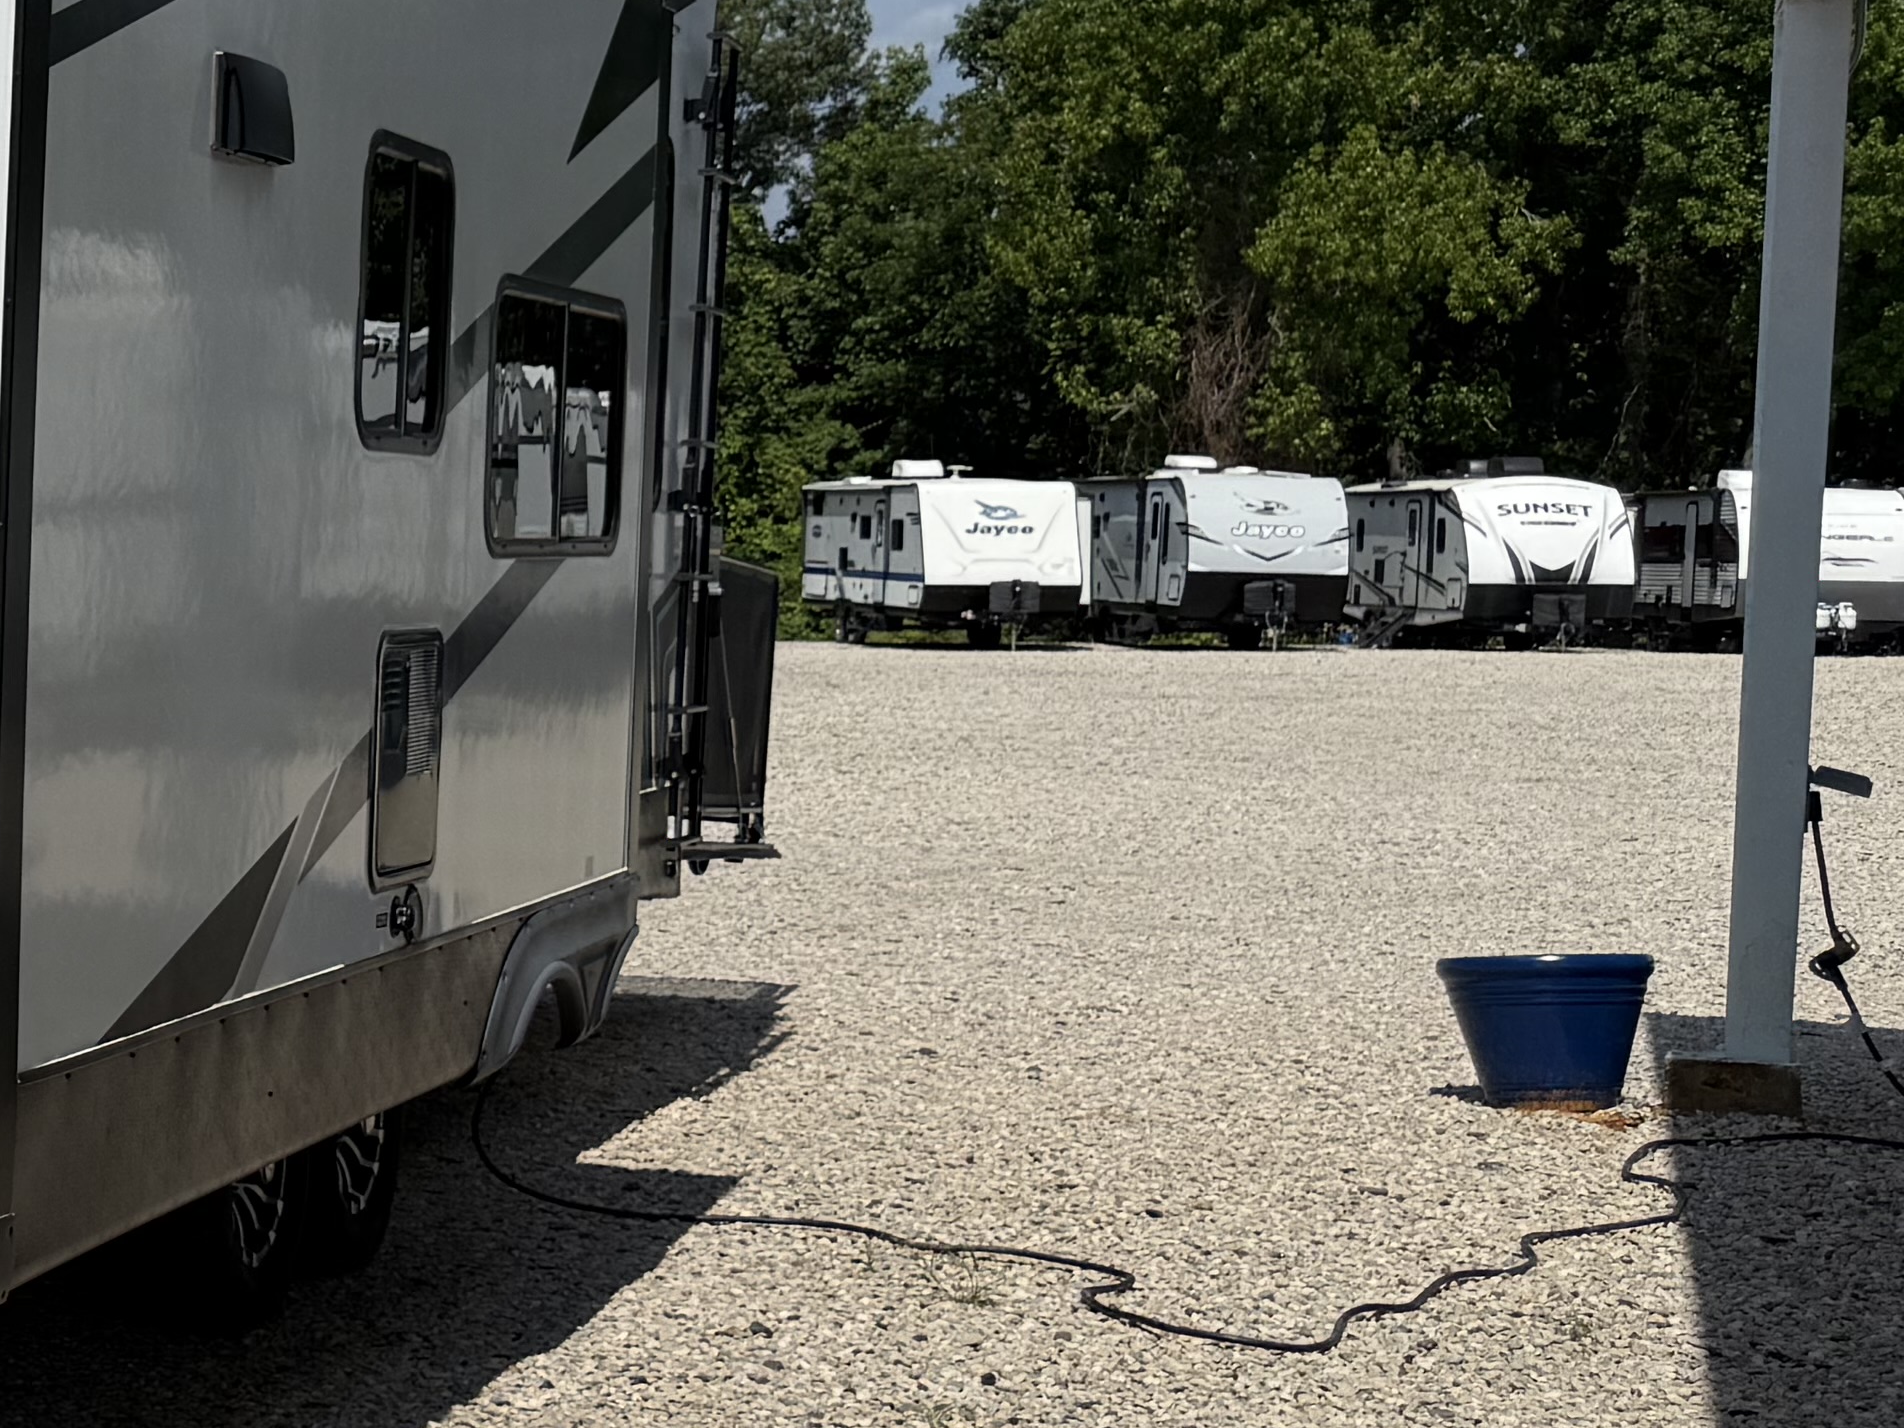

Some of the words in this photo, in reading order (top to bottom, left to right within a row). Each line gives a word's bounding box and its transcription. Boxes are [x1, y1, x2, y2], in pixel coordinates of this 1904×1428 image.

[1497, 503, 1593, 518] SUNSET
[965, 521, 1035, 537] Jayco
[1231, 521, 1306, 540] Jayco
